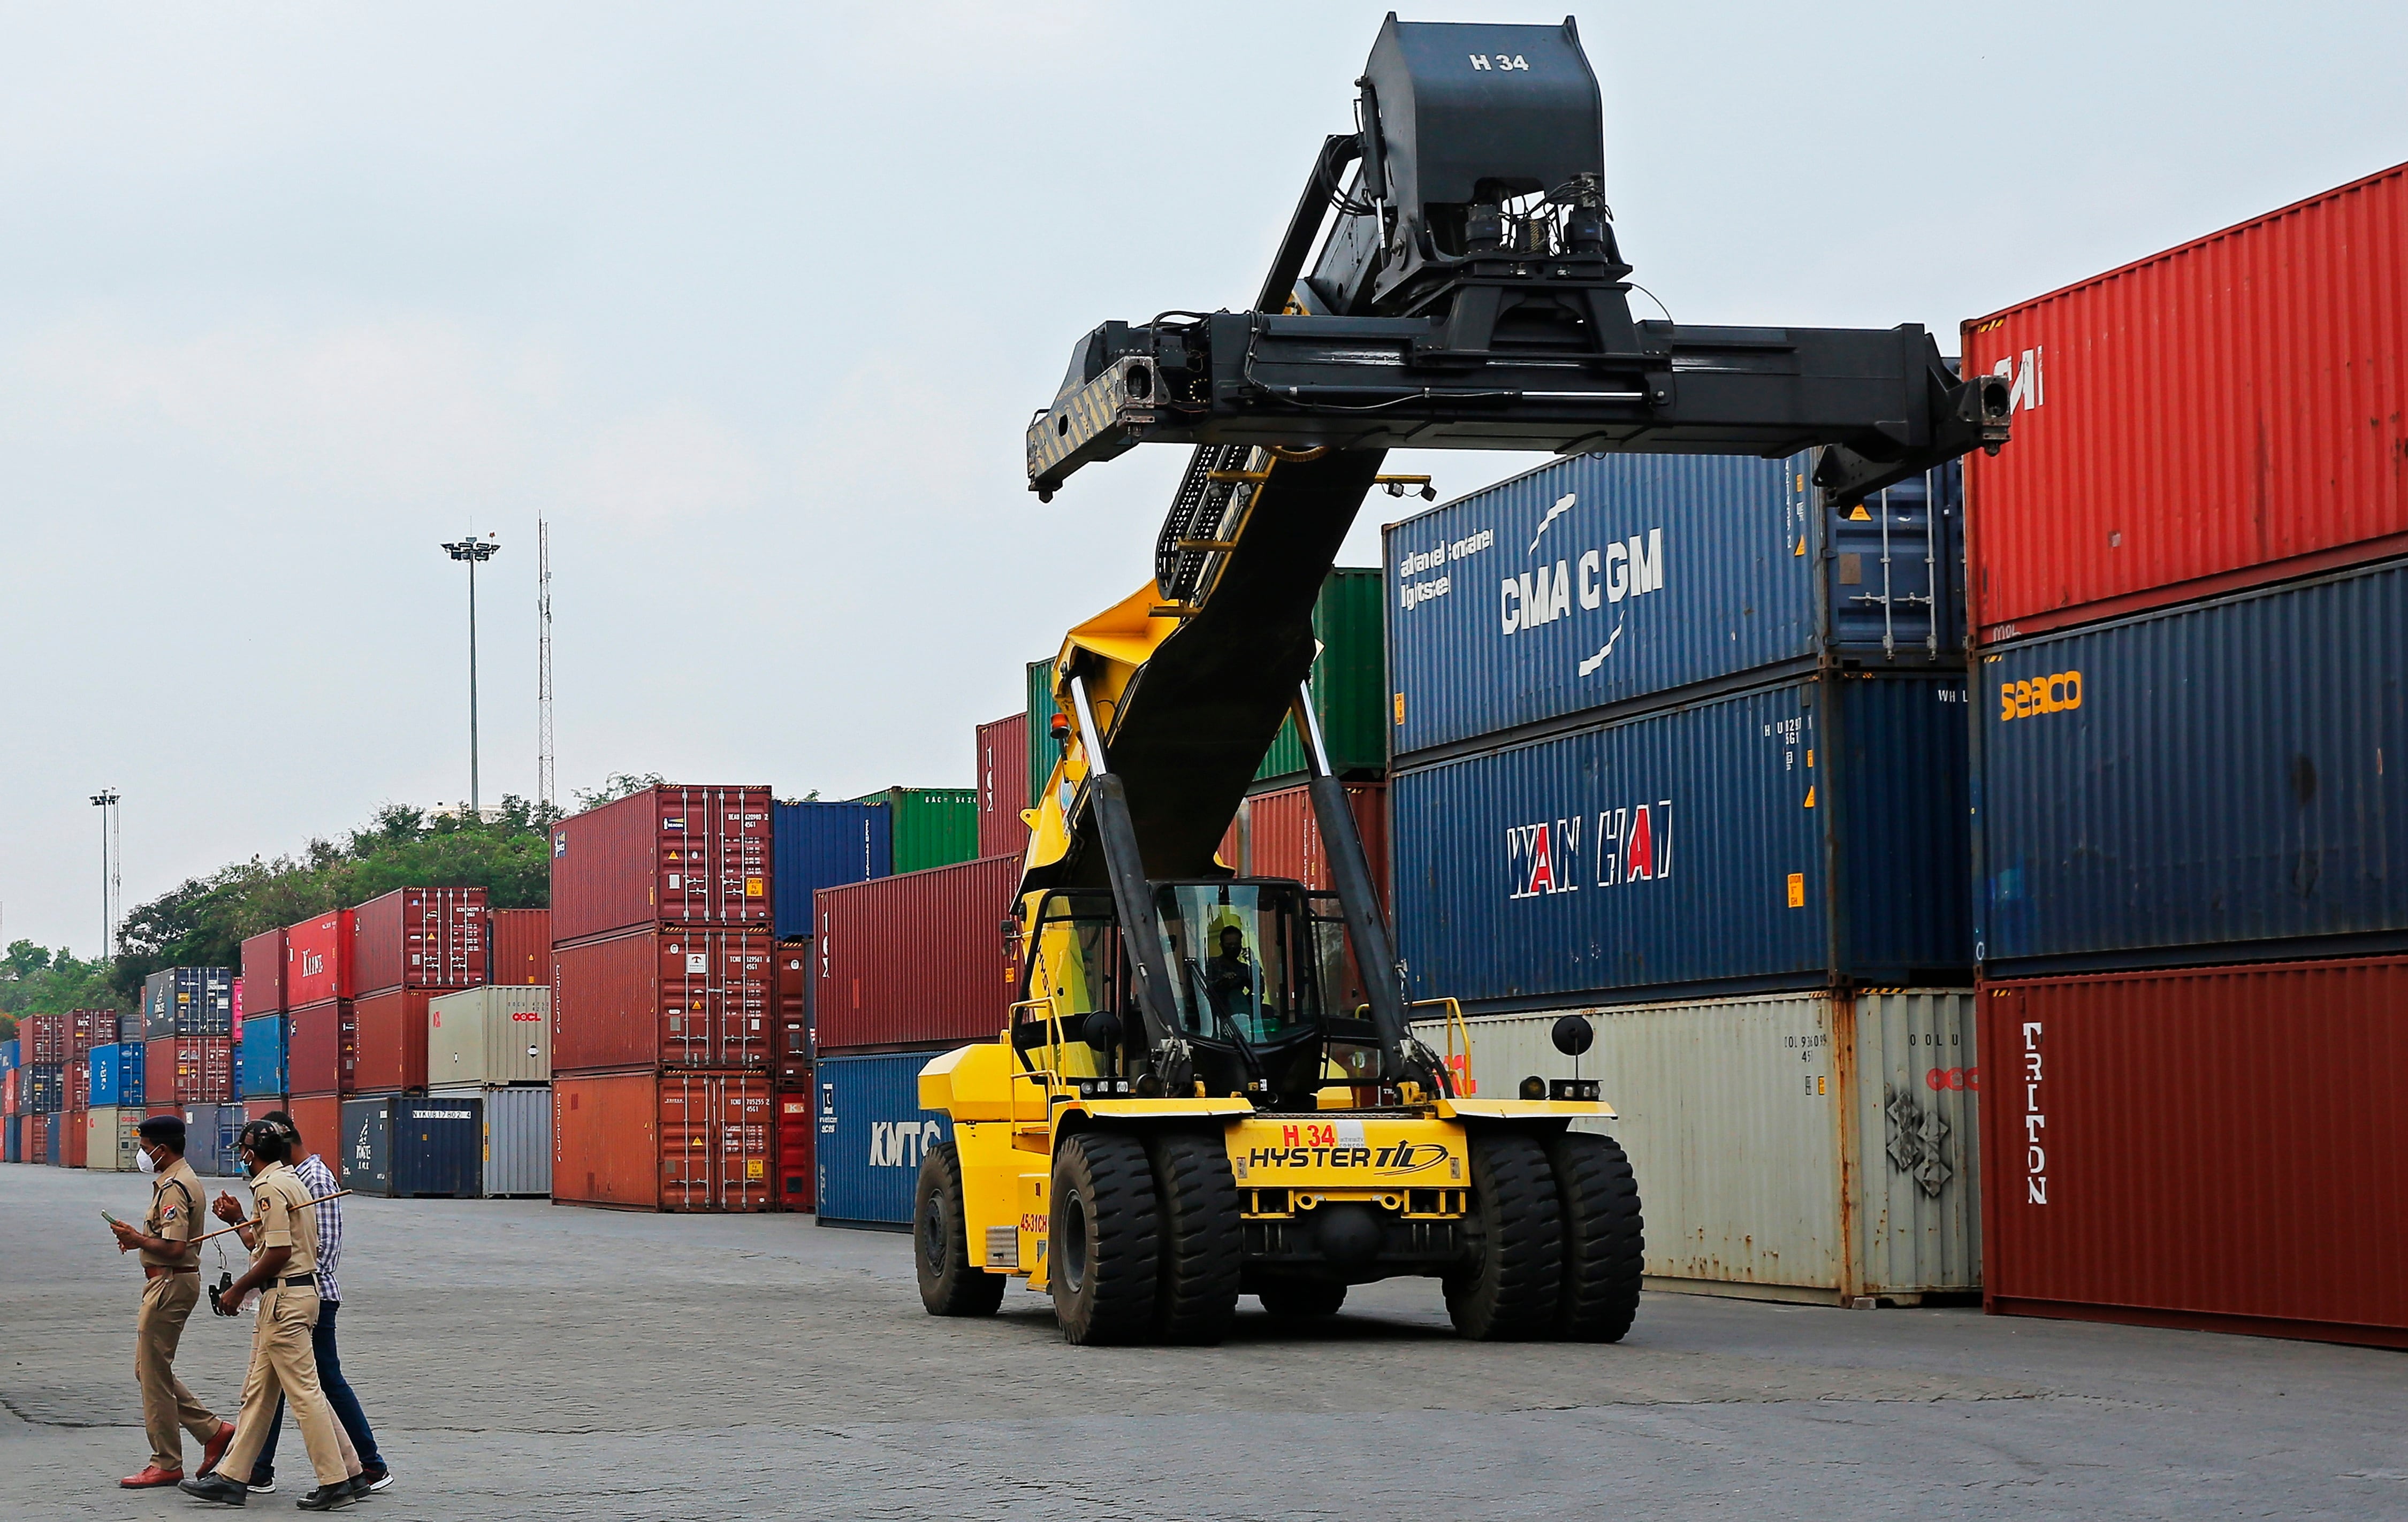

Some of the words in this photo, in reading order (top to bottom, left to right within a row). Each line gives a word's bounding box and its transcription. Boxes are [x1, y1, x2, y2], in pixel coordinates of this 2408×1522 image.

[1469, 54, 1492, 71] H
[1496, 54, 1529, 71] 34
[1501, 560, 1570, 635] CMA
[1579, 527, 1663, 611] CGM
[2000, 670, 2083, 721] seaco
[1506, 815, 1581, 899] WAN
[1597, 800, 1672, 887] HAI
[512, 1012, 542, 1021] OOCL
[869, 1120, 941, 1167] KMTC
[1283, 1125, 1300, 1147] H
[1307, 1124, 1336, 1147] 34
[1249, 1147, 1371, 1168] HYSTER
